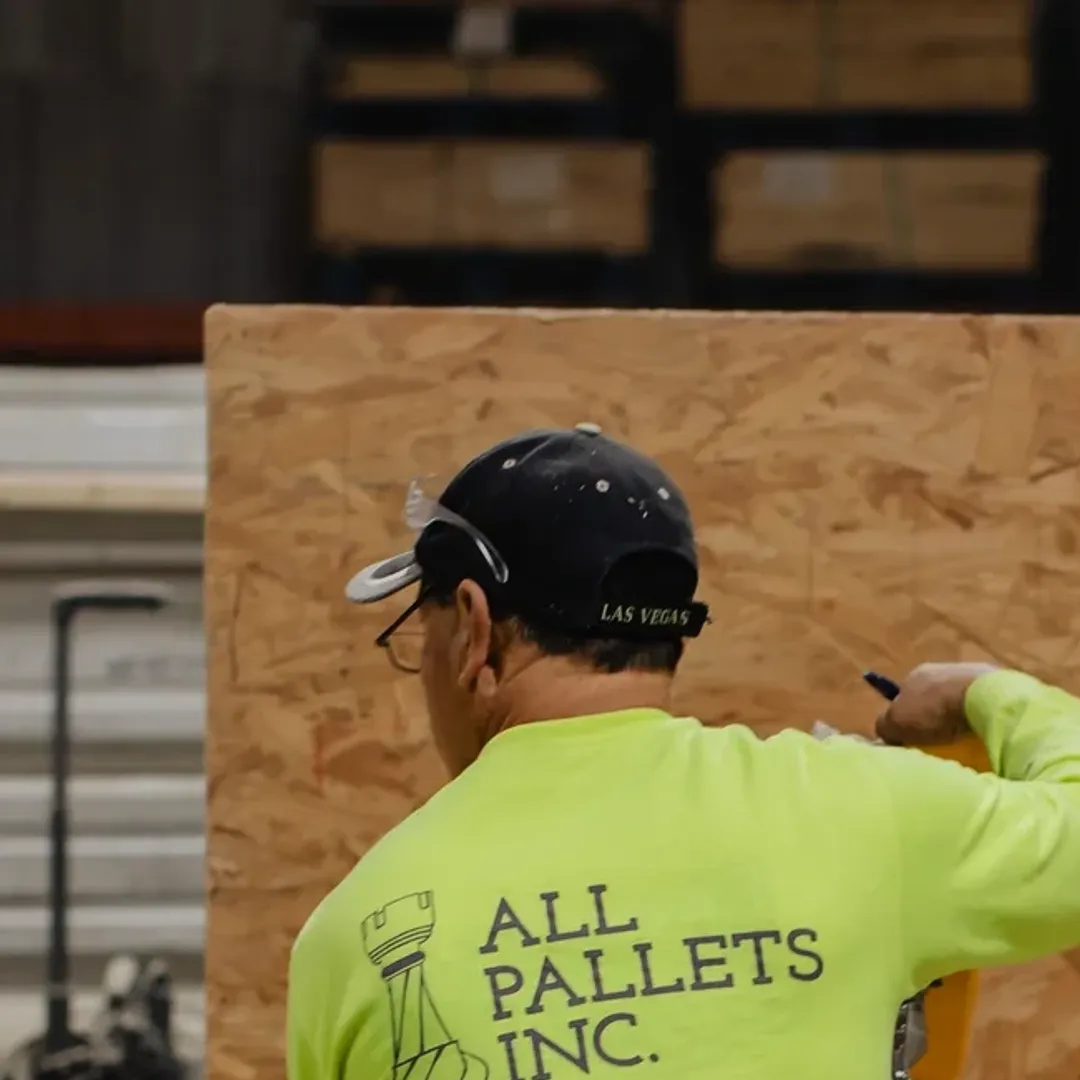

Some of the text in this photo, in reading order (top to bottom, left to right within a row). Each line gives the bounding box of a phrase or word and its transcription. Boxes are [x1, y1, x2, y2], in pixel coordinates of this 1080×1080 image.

[600, 603, 692, 626] LAS VEGAS
[478, 883, 639, 955] ALL
[483, 928, 825, 1021] PALLETS
